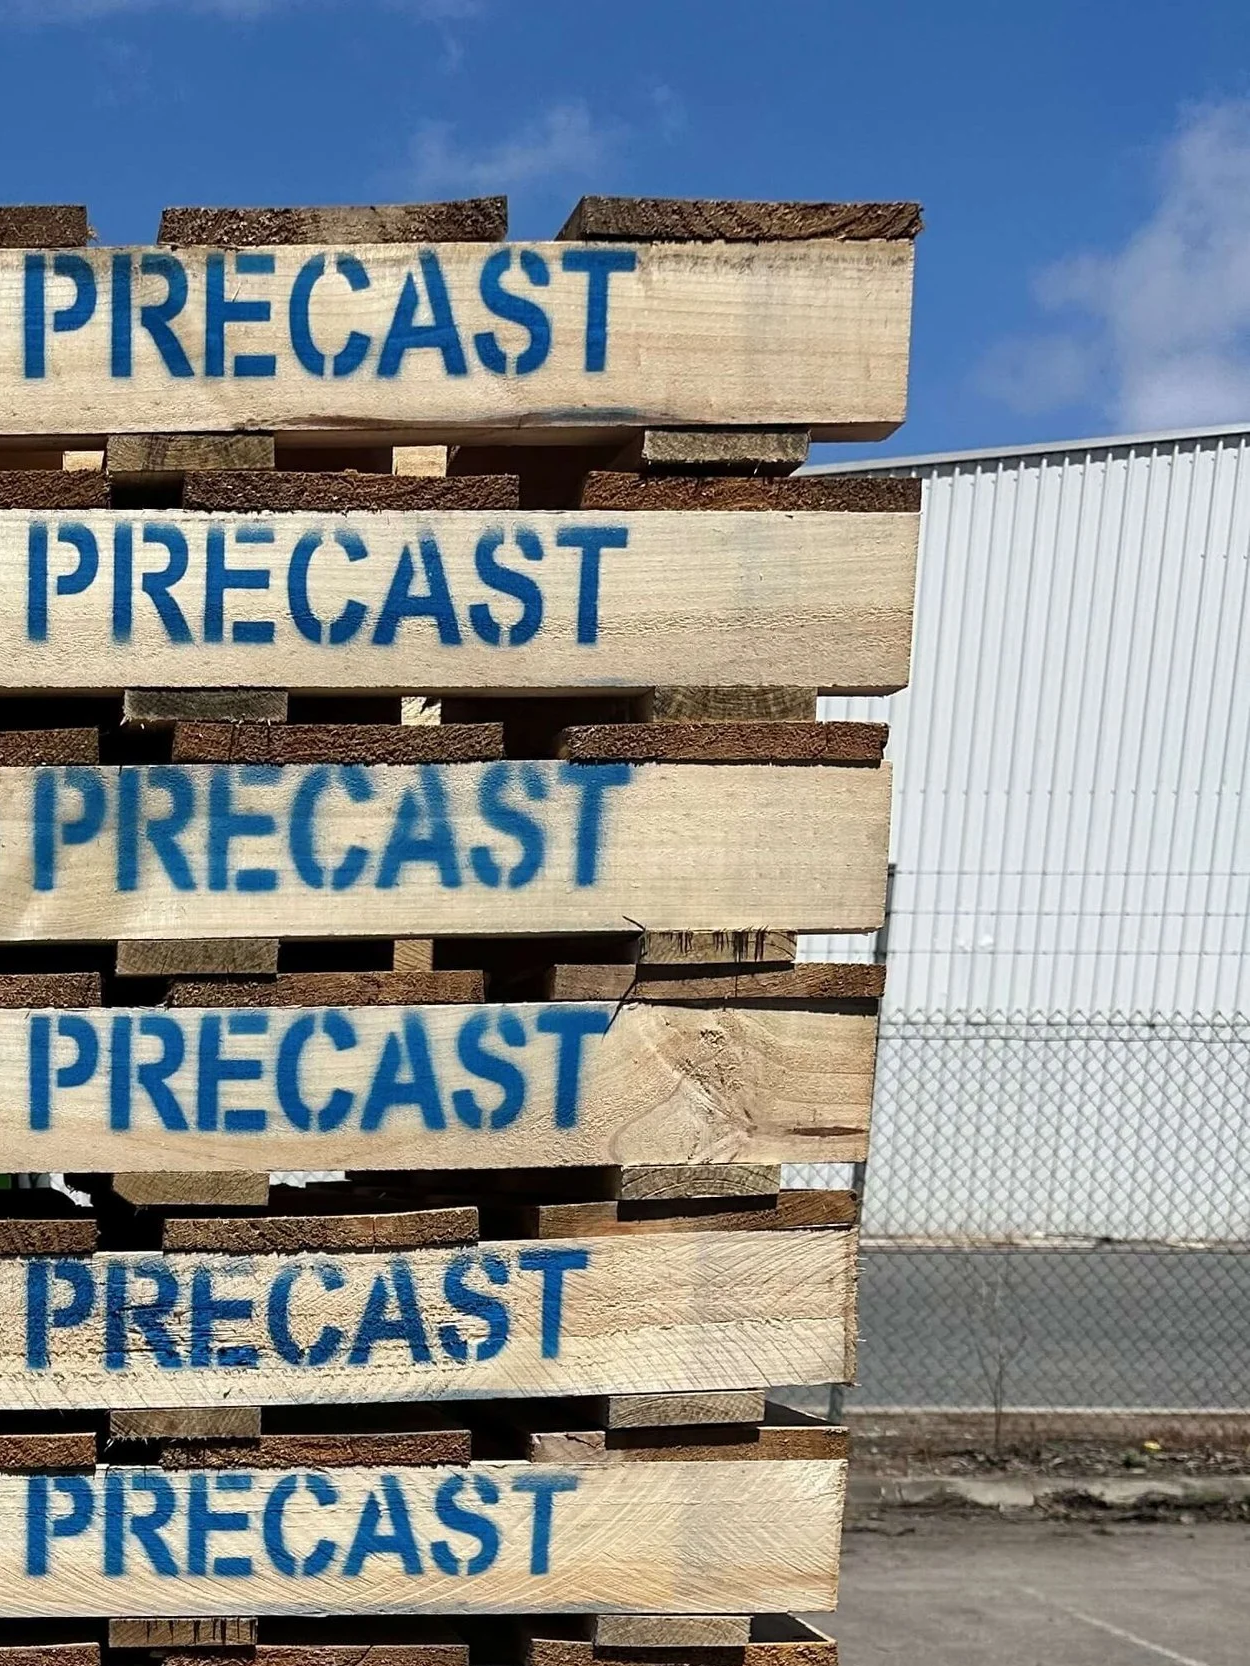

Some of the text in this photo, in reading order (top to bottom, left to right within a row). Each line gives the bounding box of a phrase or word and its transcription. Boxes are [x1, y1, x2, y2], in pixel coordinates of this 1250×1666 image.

[23, 248, 637, 380] PRECAST
[27, 523, 628, 646] PRECAST
[33, 762, 632, 893] PRECAST
[28, 1007, 611, 1132] PRECAST
[26, 1249, 589, 1370] PRECAST
[26, 1473, 575, 1577] PRECAST
